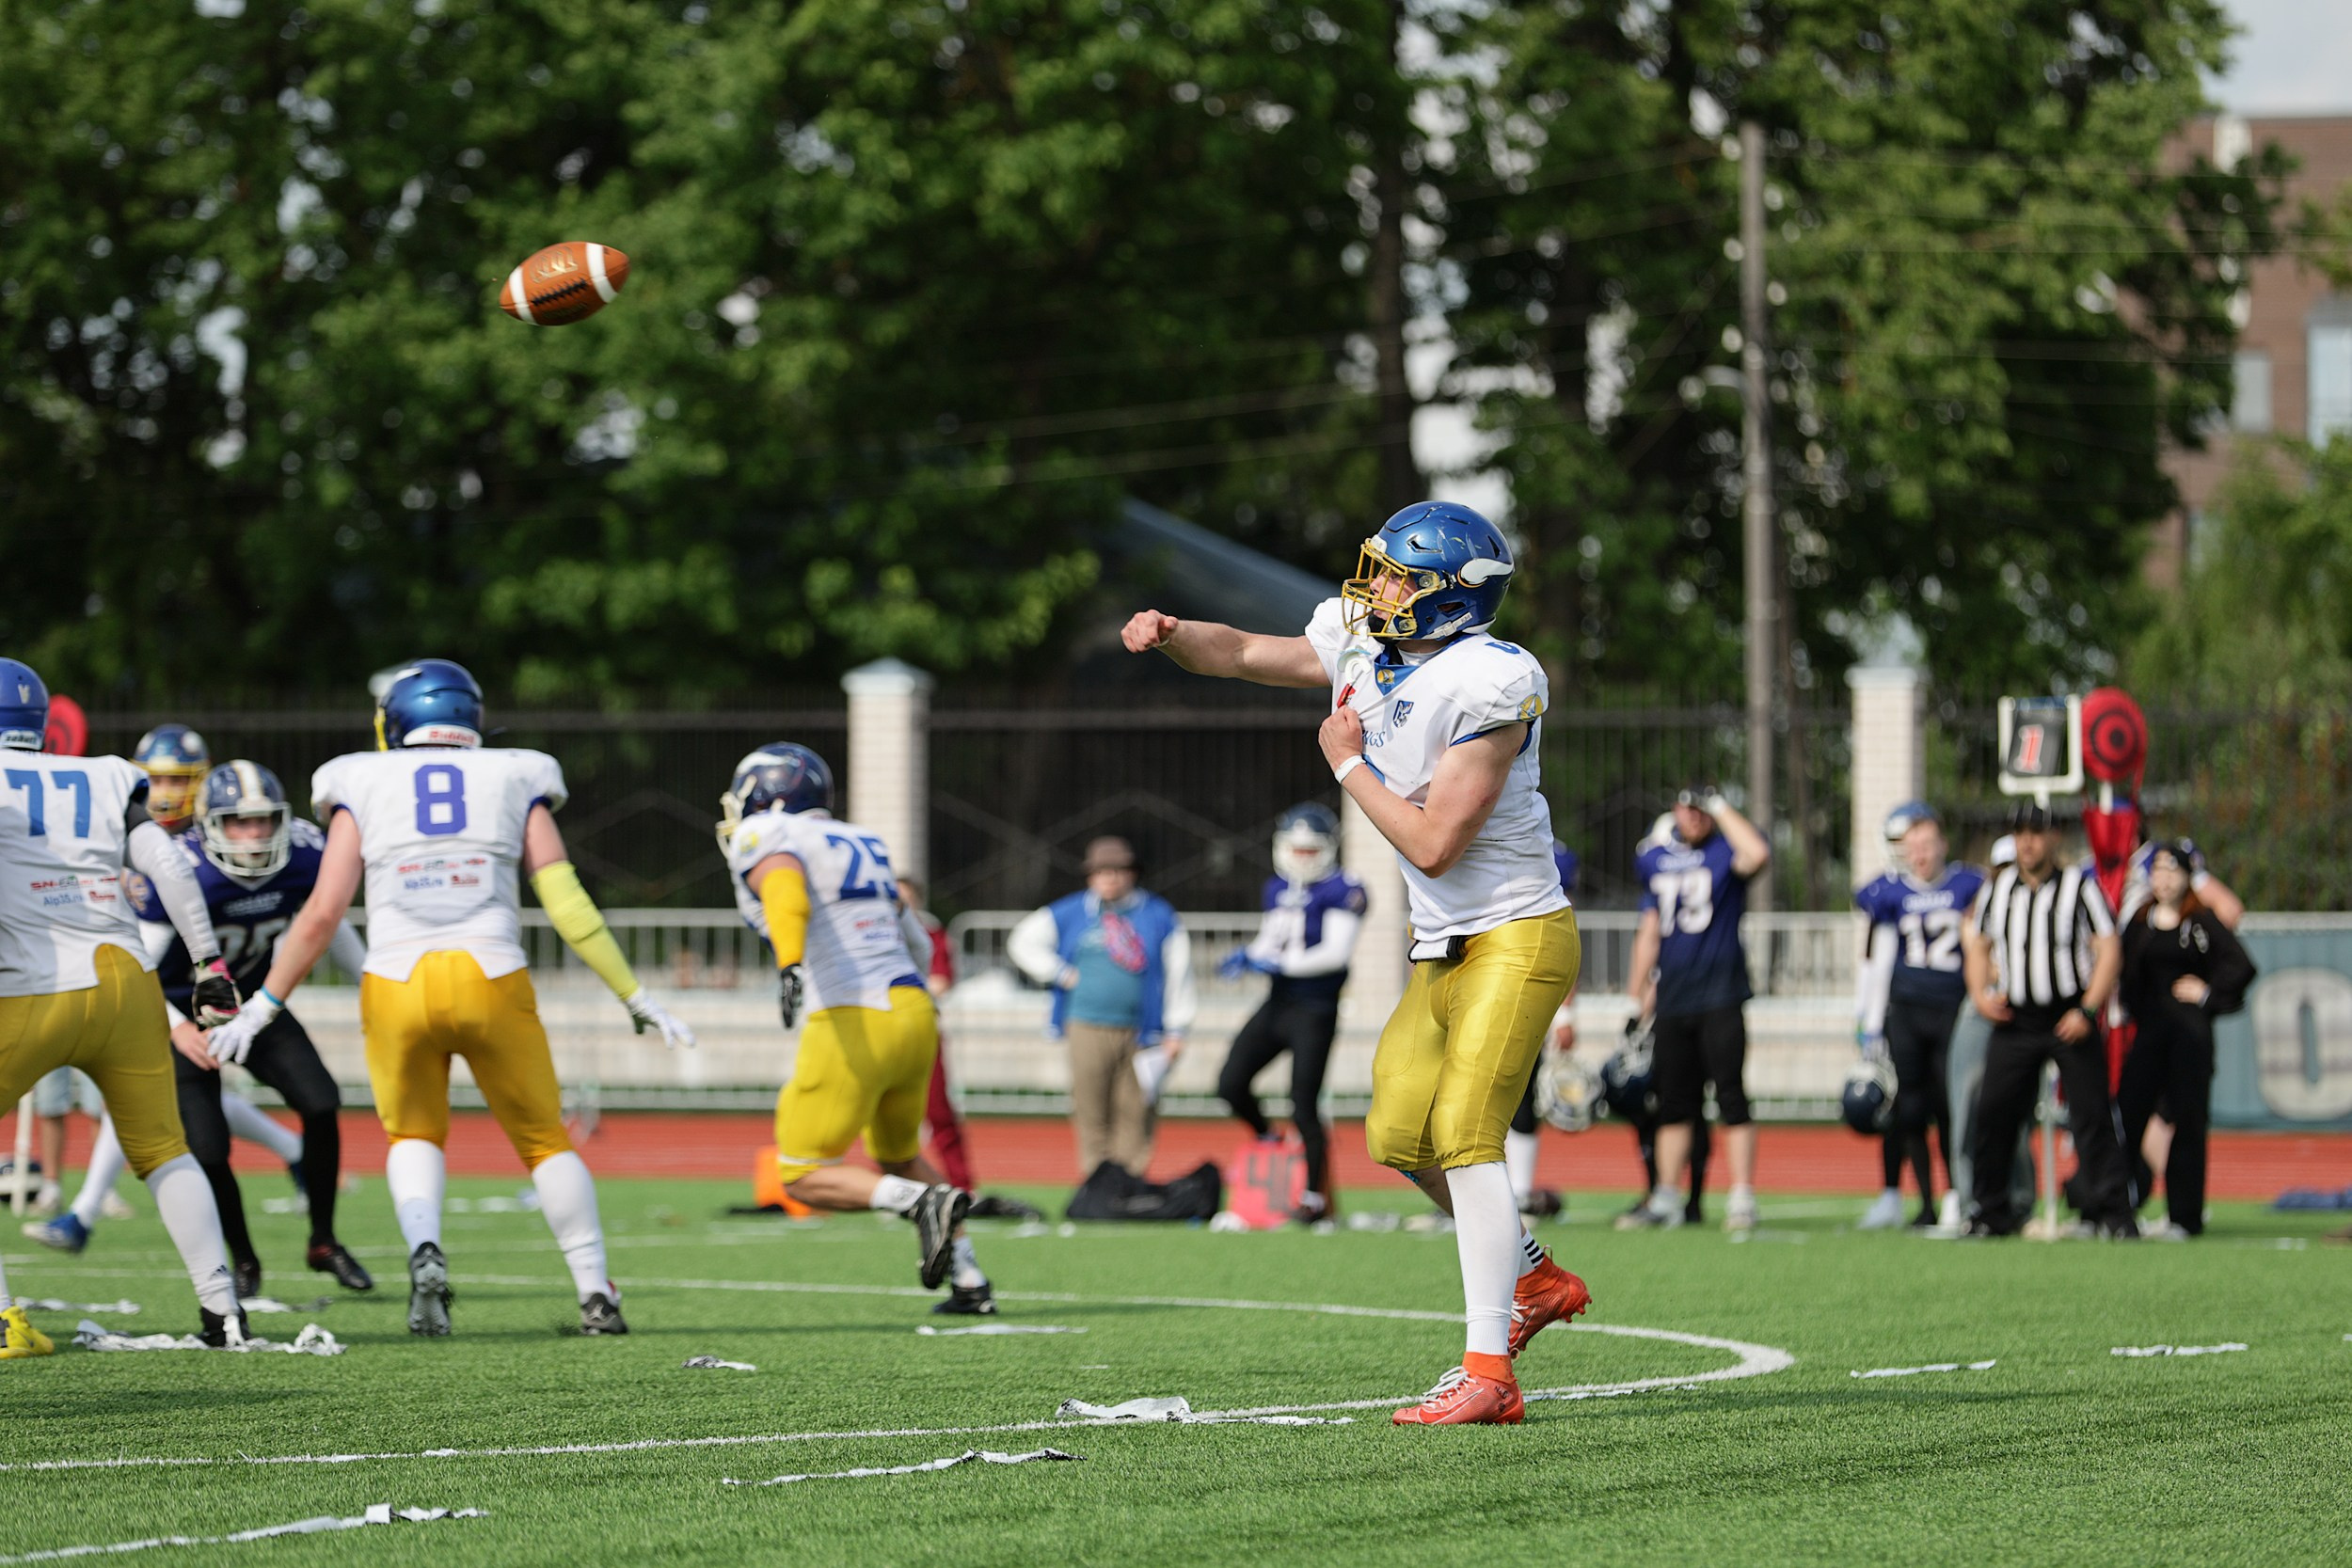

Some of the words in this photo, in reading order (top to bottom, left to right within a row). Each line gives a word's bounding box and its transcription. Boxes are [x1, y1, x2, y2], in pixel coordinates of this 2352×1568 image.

[4, 768, 91, 838] 77
[415, 764, 467, 835] 8
[1899, 909, 1963, 973] 12
